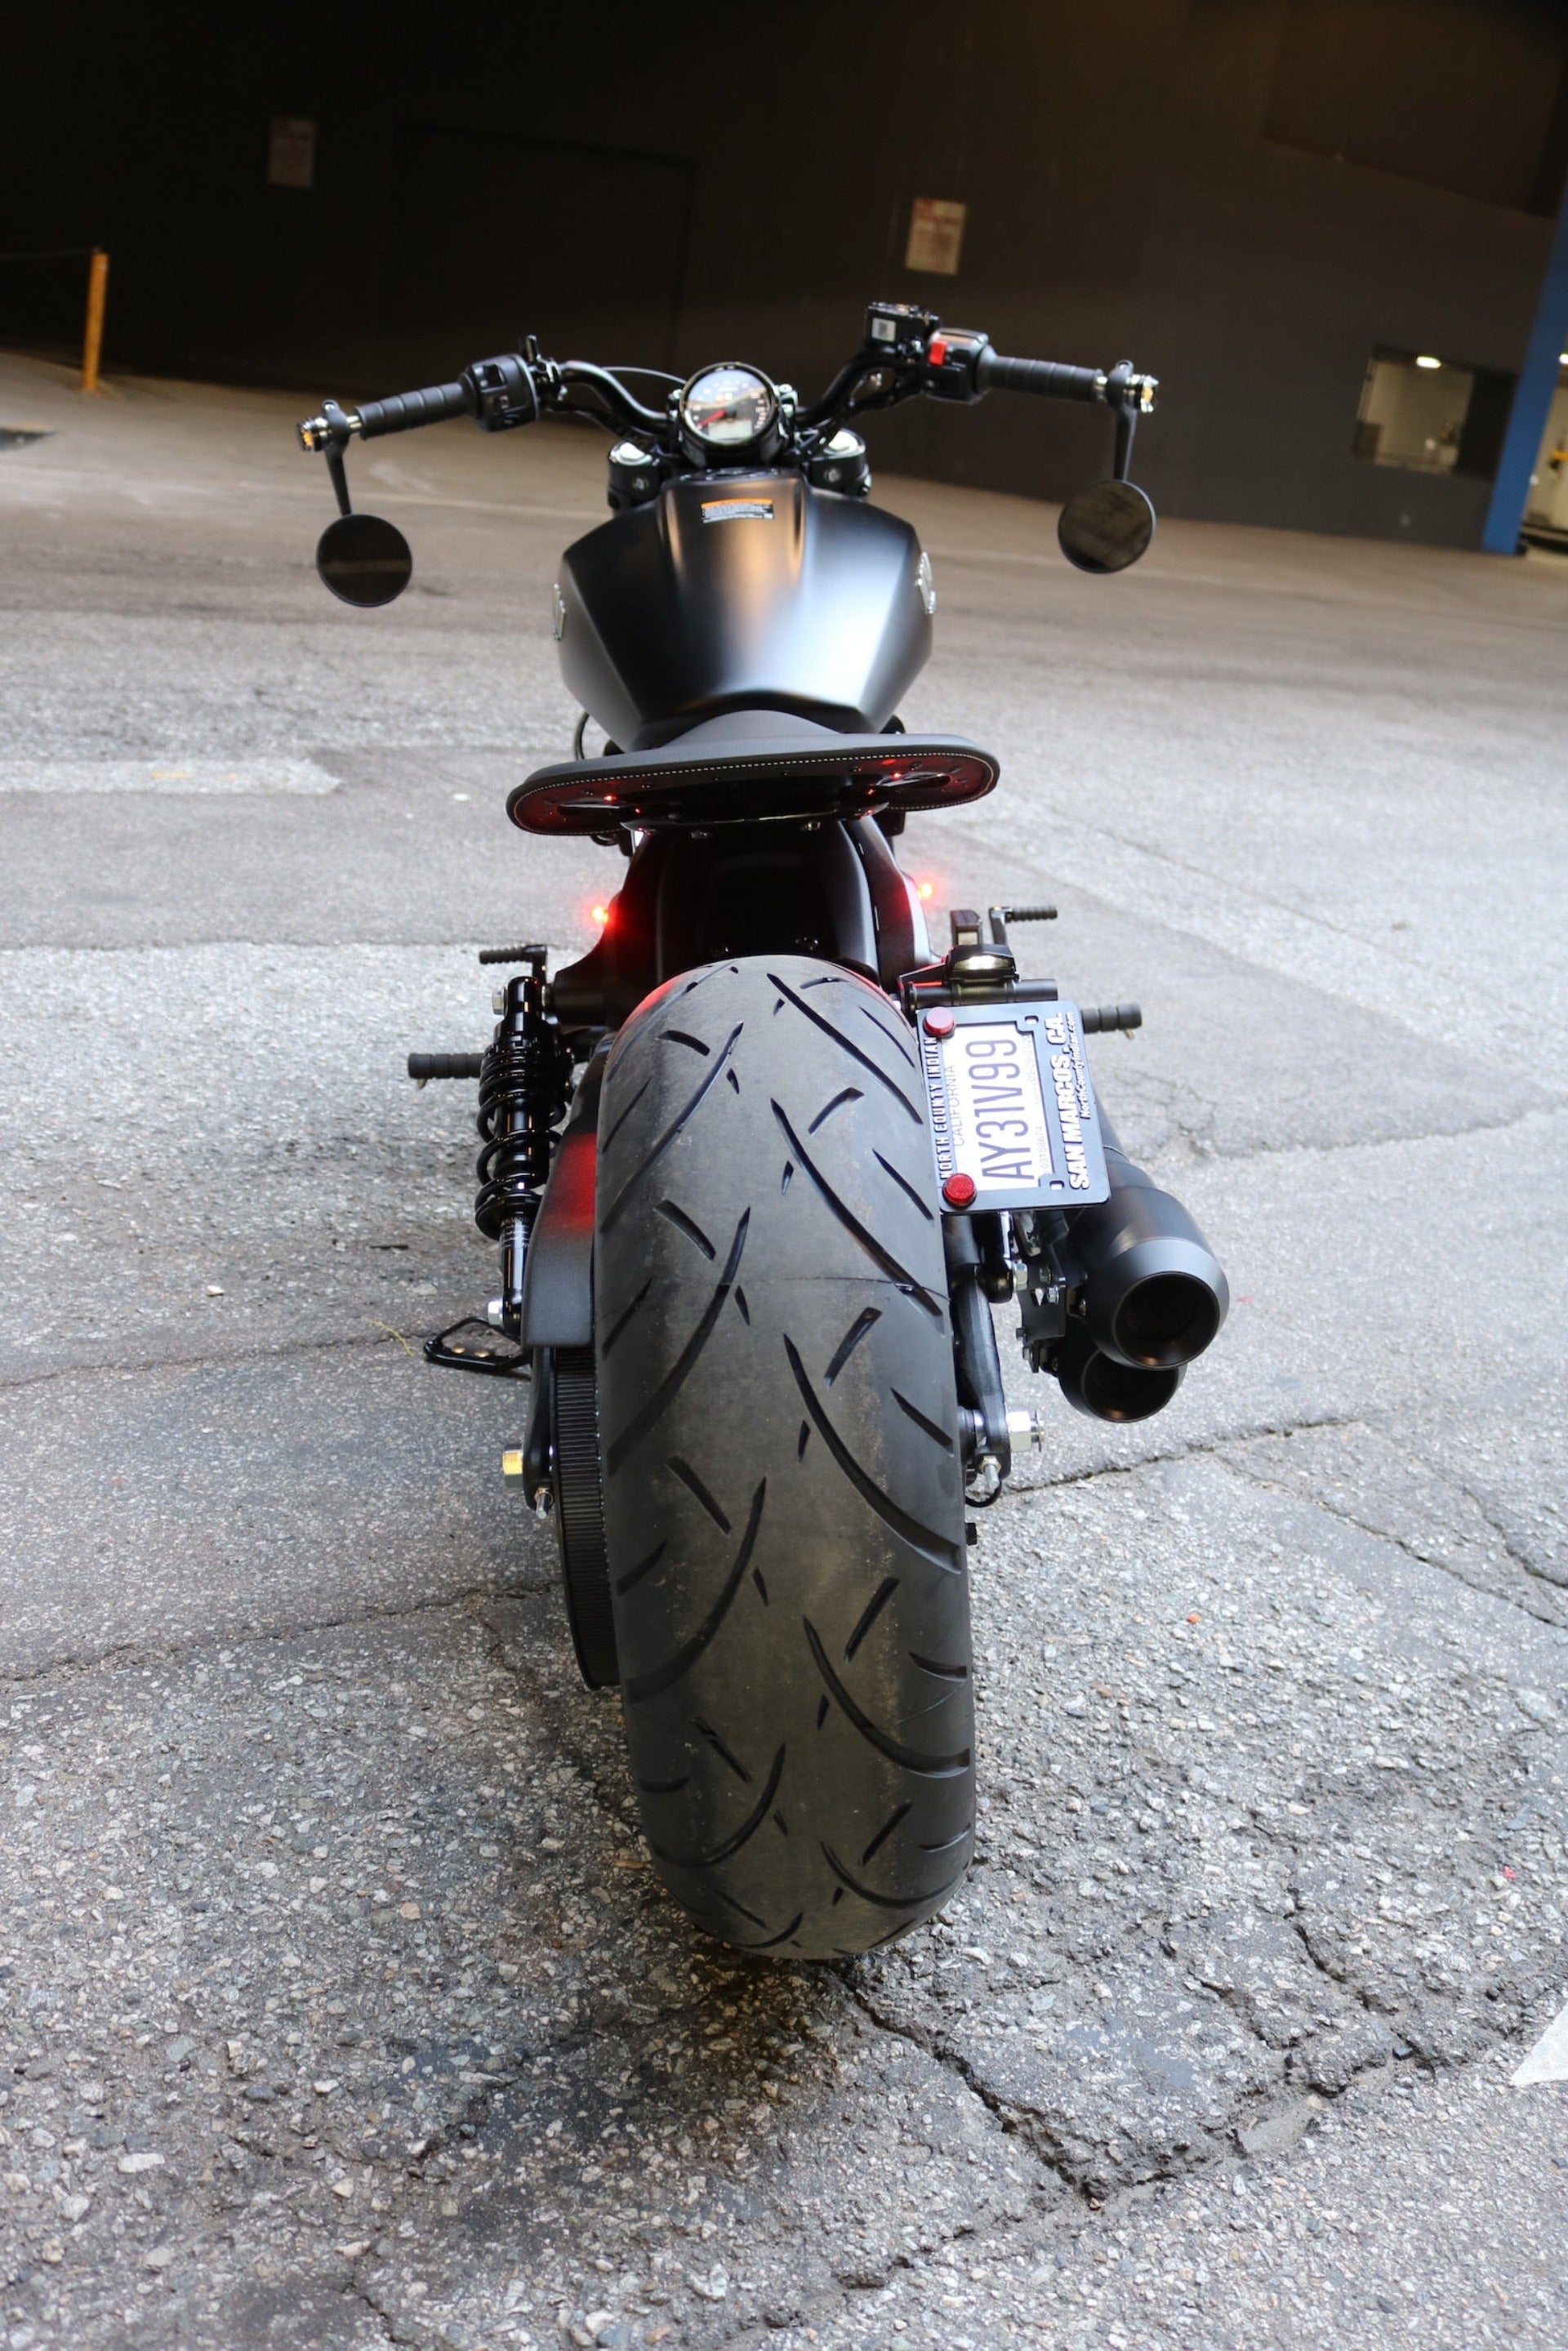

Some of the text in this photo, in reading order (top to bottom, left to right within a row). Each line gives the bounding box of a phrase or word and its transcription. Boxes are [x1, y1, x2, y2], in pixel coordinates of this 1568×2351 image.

[924, 1037, 953, 1179] NORTH COUNTY INDIAN
[945, 1064, 964, 1147] CALIFORNIA
[965, 1040, 1035, 1179] AY31V99
[1065, 1012, 1091, 1120] NorthCountyIndian.com
[1064, 1145, 1089, 1190] SAN
